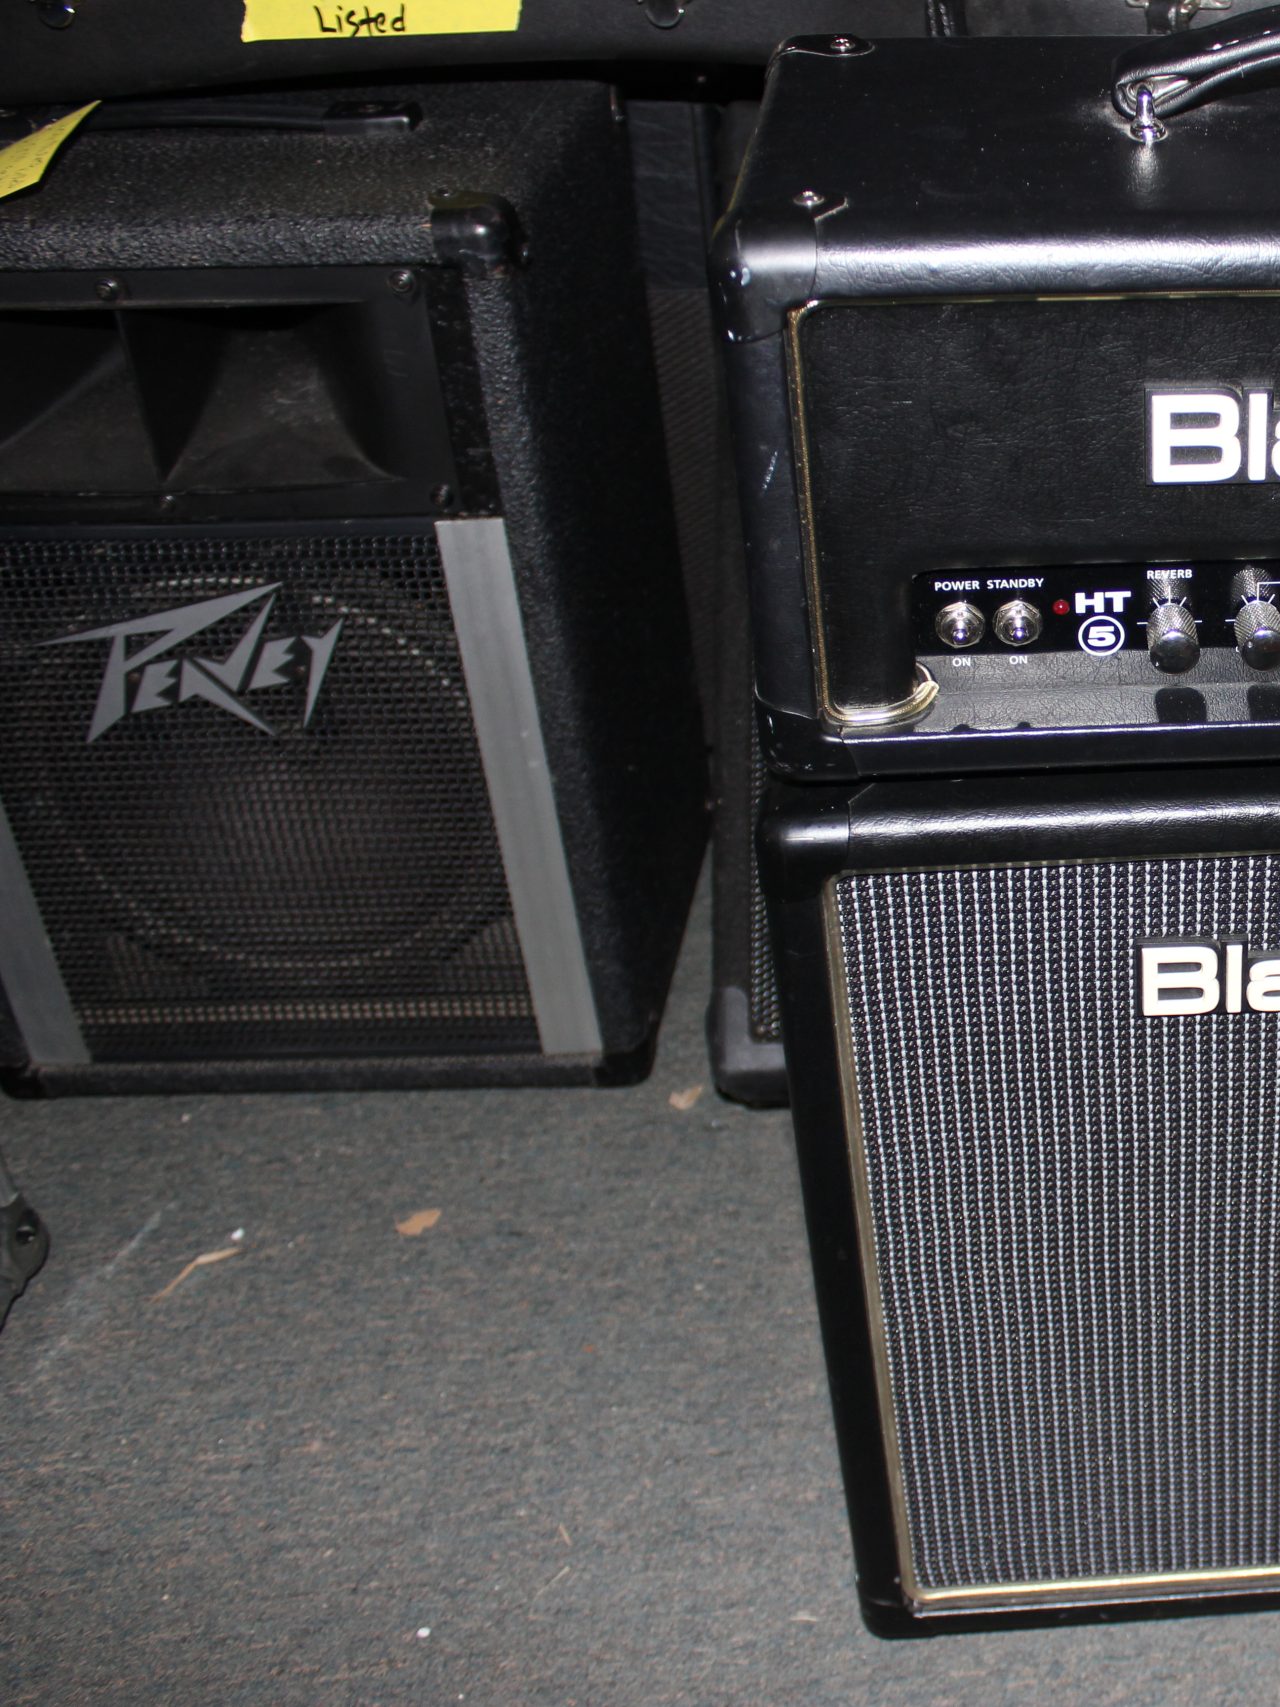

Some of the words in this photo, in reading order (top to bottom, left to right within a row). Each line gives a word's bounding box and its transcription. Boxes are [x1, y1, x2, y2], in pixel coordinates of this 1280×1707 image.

[313, 3, 406, 37] Listed
[1146, 568, 1193, 580] REVERB
[934, 580, 981, 592] POWER
[986, 577, 1045, 590] STANDBY
[1074, 590, 1132, 614] HT
[952, 658, 971, 667] ON
[1009, 656, 1028, 665] ON
